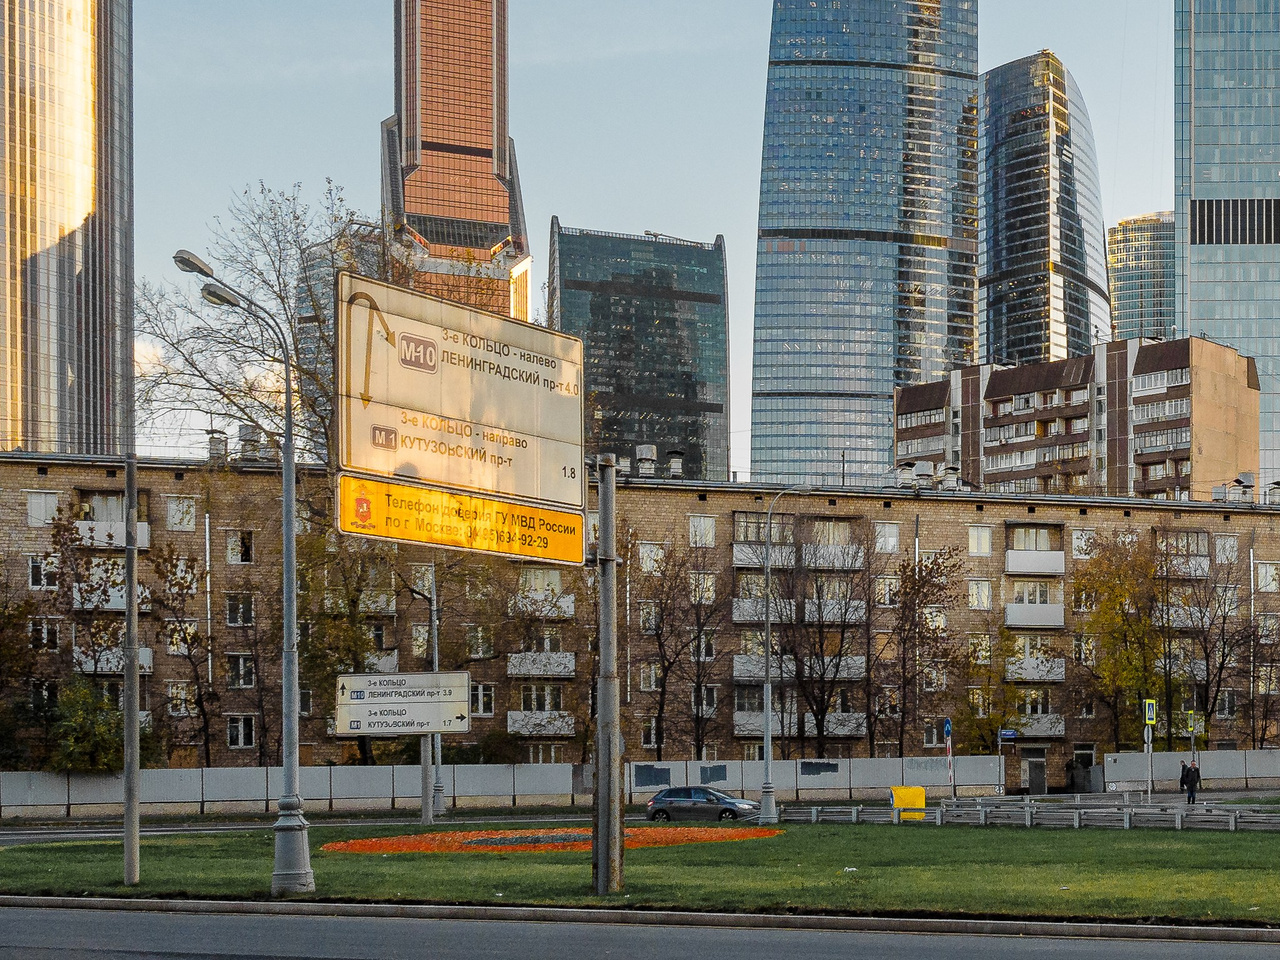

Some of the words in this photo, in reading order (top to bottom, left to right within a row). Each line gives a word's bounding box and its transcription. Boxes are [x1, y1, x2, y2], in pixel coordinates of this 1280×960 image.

[443, 328, 459, 344] 3-е
[462, 333, 510, 357] КОЛЬЦО
[519, 351, 557, 369] налево
[441, 350, 540, 386] ЛЕНИНГРАДСКИЙ
[543, 377, 564, 392] пр-т
[565, 382, 579, 396] 4.0
[400, 411, 418, 427] 3-е
[422, 413, 473, 439] КОЛЬЦО
[482, 431, 528, 450] направо
[400, 434, 487, 463] КУТУЗОВСКИЙ
[490, 453, 513, 468] пр-т
[562, 466, 576, 480] 1.8
[385, 494, 440, 514] Телефон
[442, 505, 492, 524] доверия
[495, 511, 508, 525] ГУ
[511, 515, 536, 532] МВД
[539, 518, 576, 536] России
[385, 516, 401, 528] по
[415, 517, 463, 537] Москве:
[351, 691, 365, 699] М10
[367, 689, 426, 699] ЛЕНИНГРАДСКИЙ
[378, 679, 407, 688] КОЛЬЦО
[378, 709, 407, 717] КОЛЬЦО
[350, 721, 361, 729] М1
[367, 719, 415, 728] КУТУЗОВСКИЙ
[416, 721, 430, 729] пр-т
